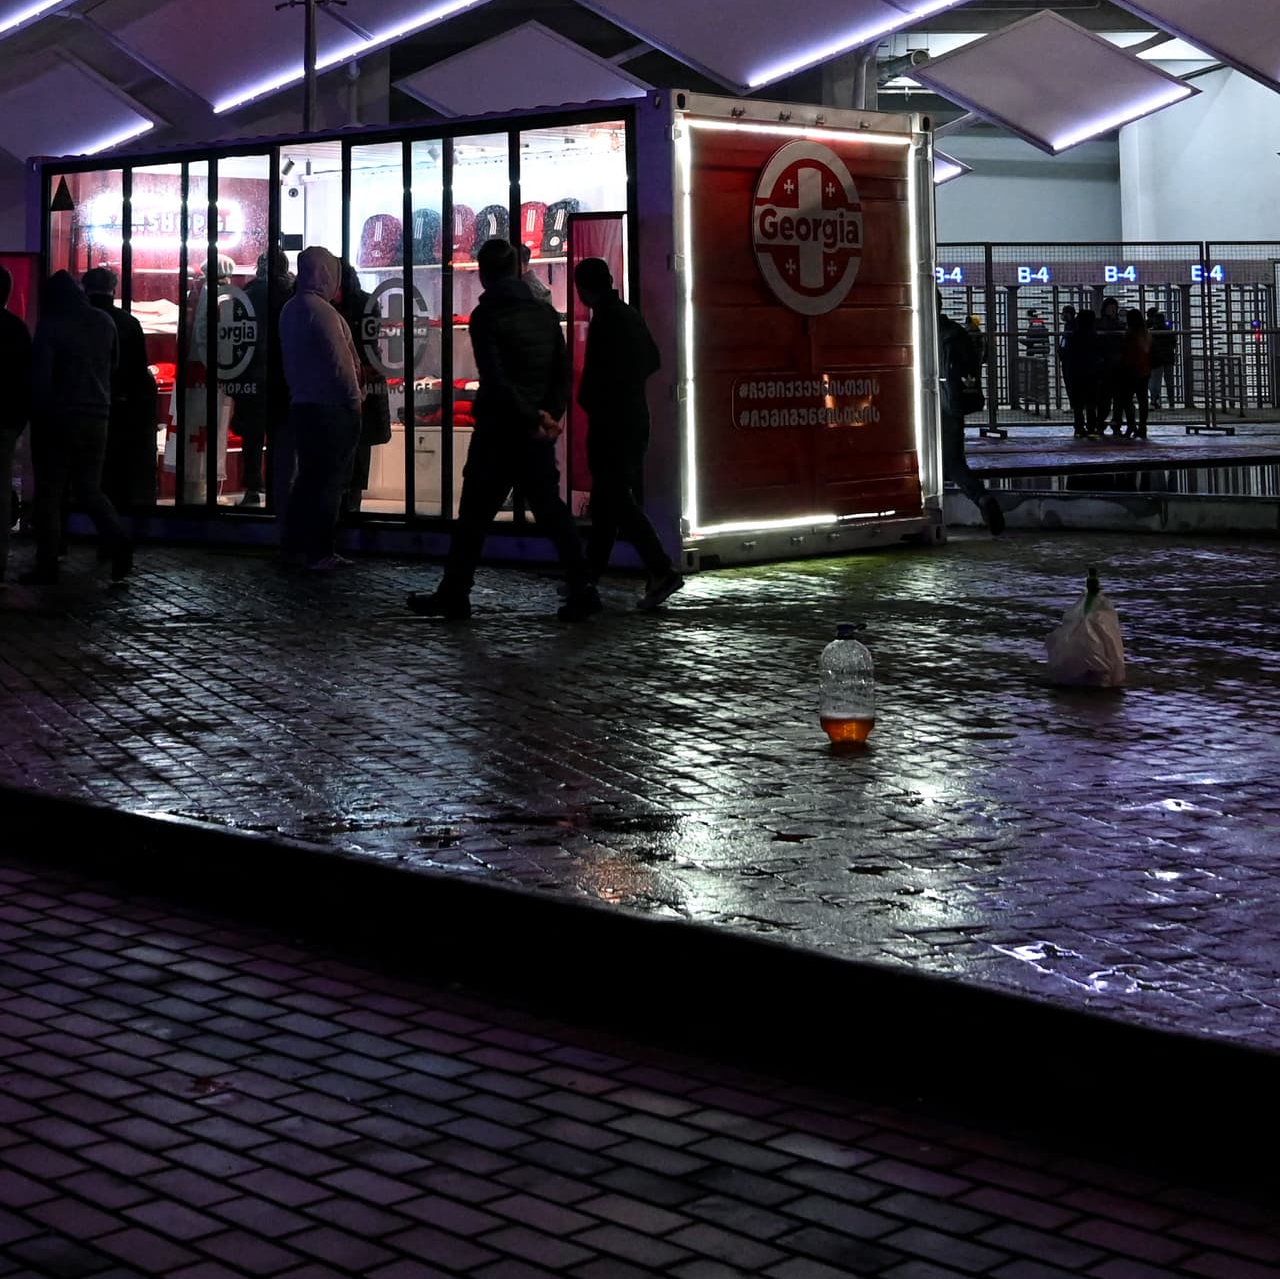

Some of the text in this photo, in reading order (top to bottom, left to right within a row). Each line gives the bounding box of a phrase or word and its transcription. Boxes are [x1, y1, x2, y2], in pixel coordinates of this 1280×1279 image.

[759, 208, 859, 249] Georgia
[1018, 266, 1049, 283] B-4
[1104, 265, 1136, 282] B-4
